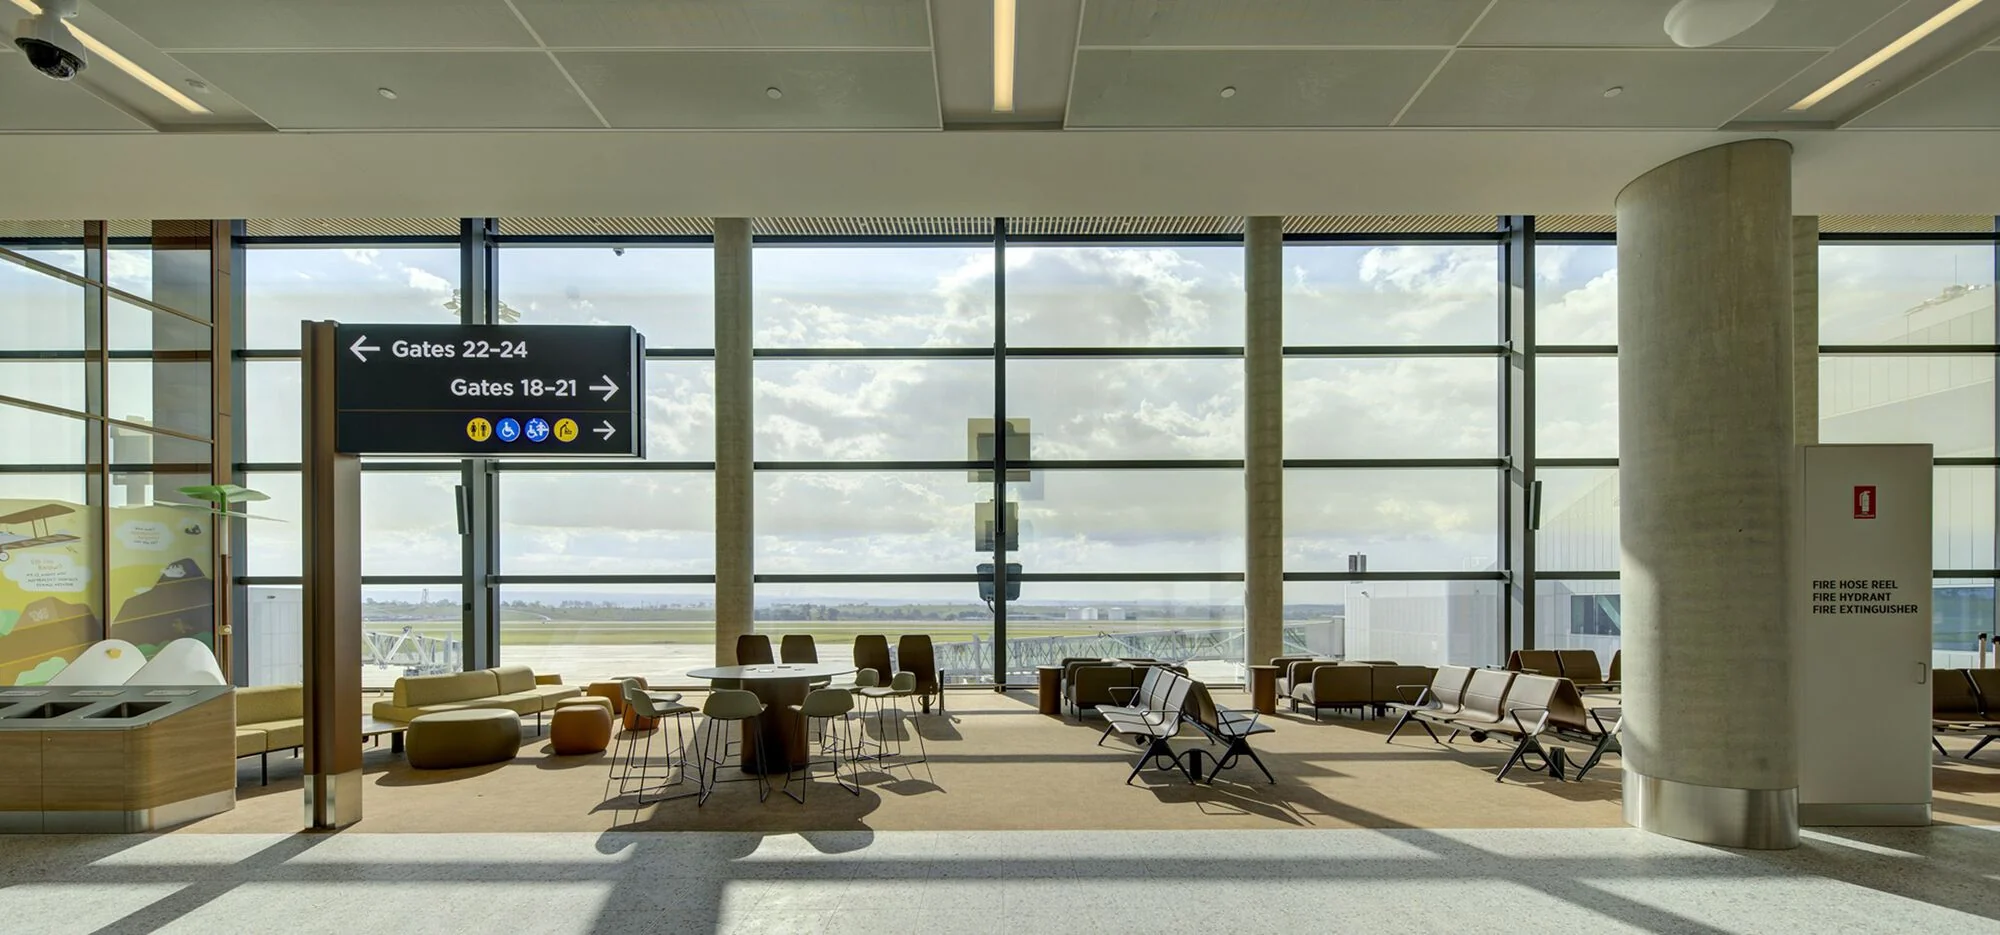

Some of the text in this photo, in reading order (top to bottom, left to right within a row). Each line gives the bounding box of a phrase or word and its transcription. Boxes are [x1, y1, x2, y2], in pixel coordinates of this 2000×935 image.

[391, 339, 456, 358] Gates
[450, 378, 514, 397] Gates
[1812, 580, 1898, 589] FIRE HOSE REEL
[1812, 592, 1892, 602] FIRE HYDRANT
[1812, 604, 1918, 614] FIRE EXTINGUISHER
